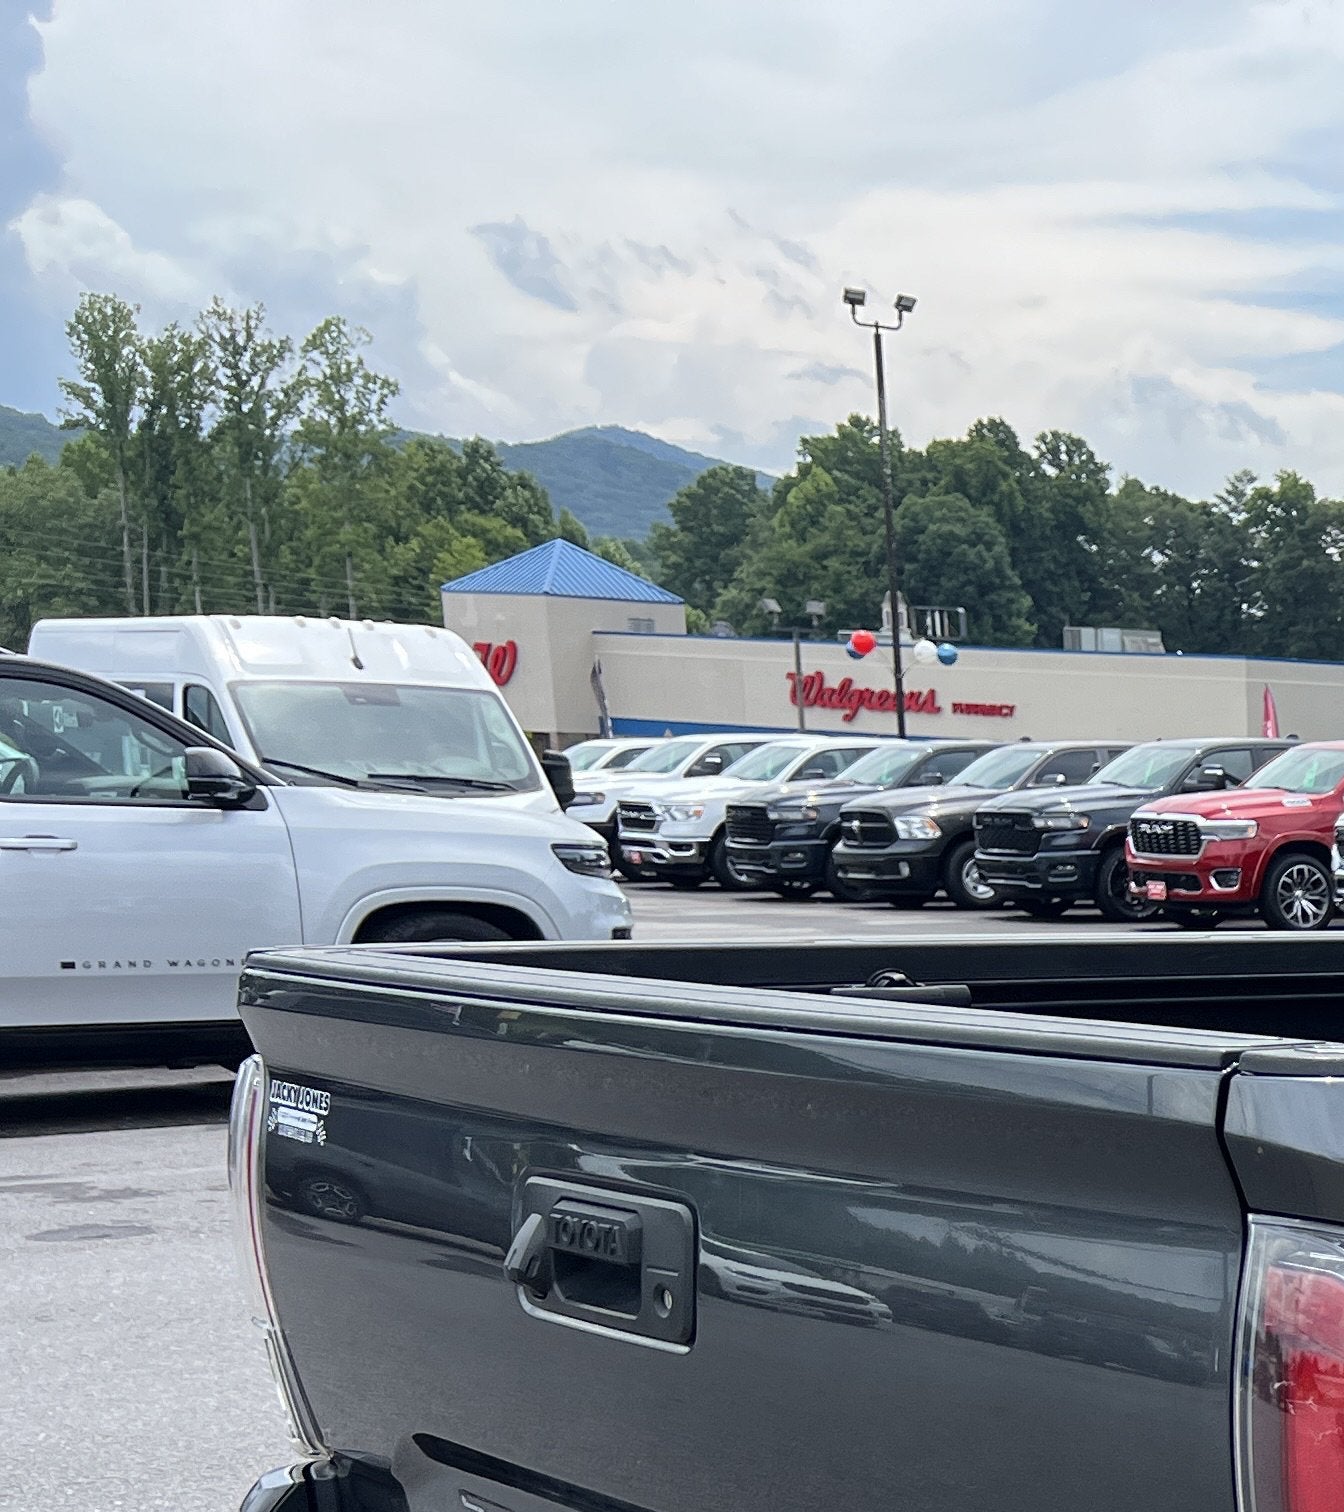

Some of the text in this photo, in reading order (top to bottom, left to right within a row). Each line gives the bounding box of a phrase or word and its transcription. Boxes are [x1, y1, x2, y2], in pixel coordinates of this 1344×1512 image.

[82, 958, 246, 969] GRAND WAGON
[270, 1080, 331, 1116] JACKY JONES
[549, 1212, 621, 1256] TOYOTA
